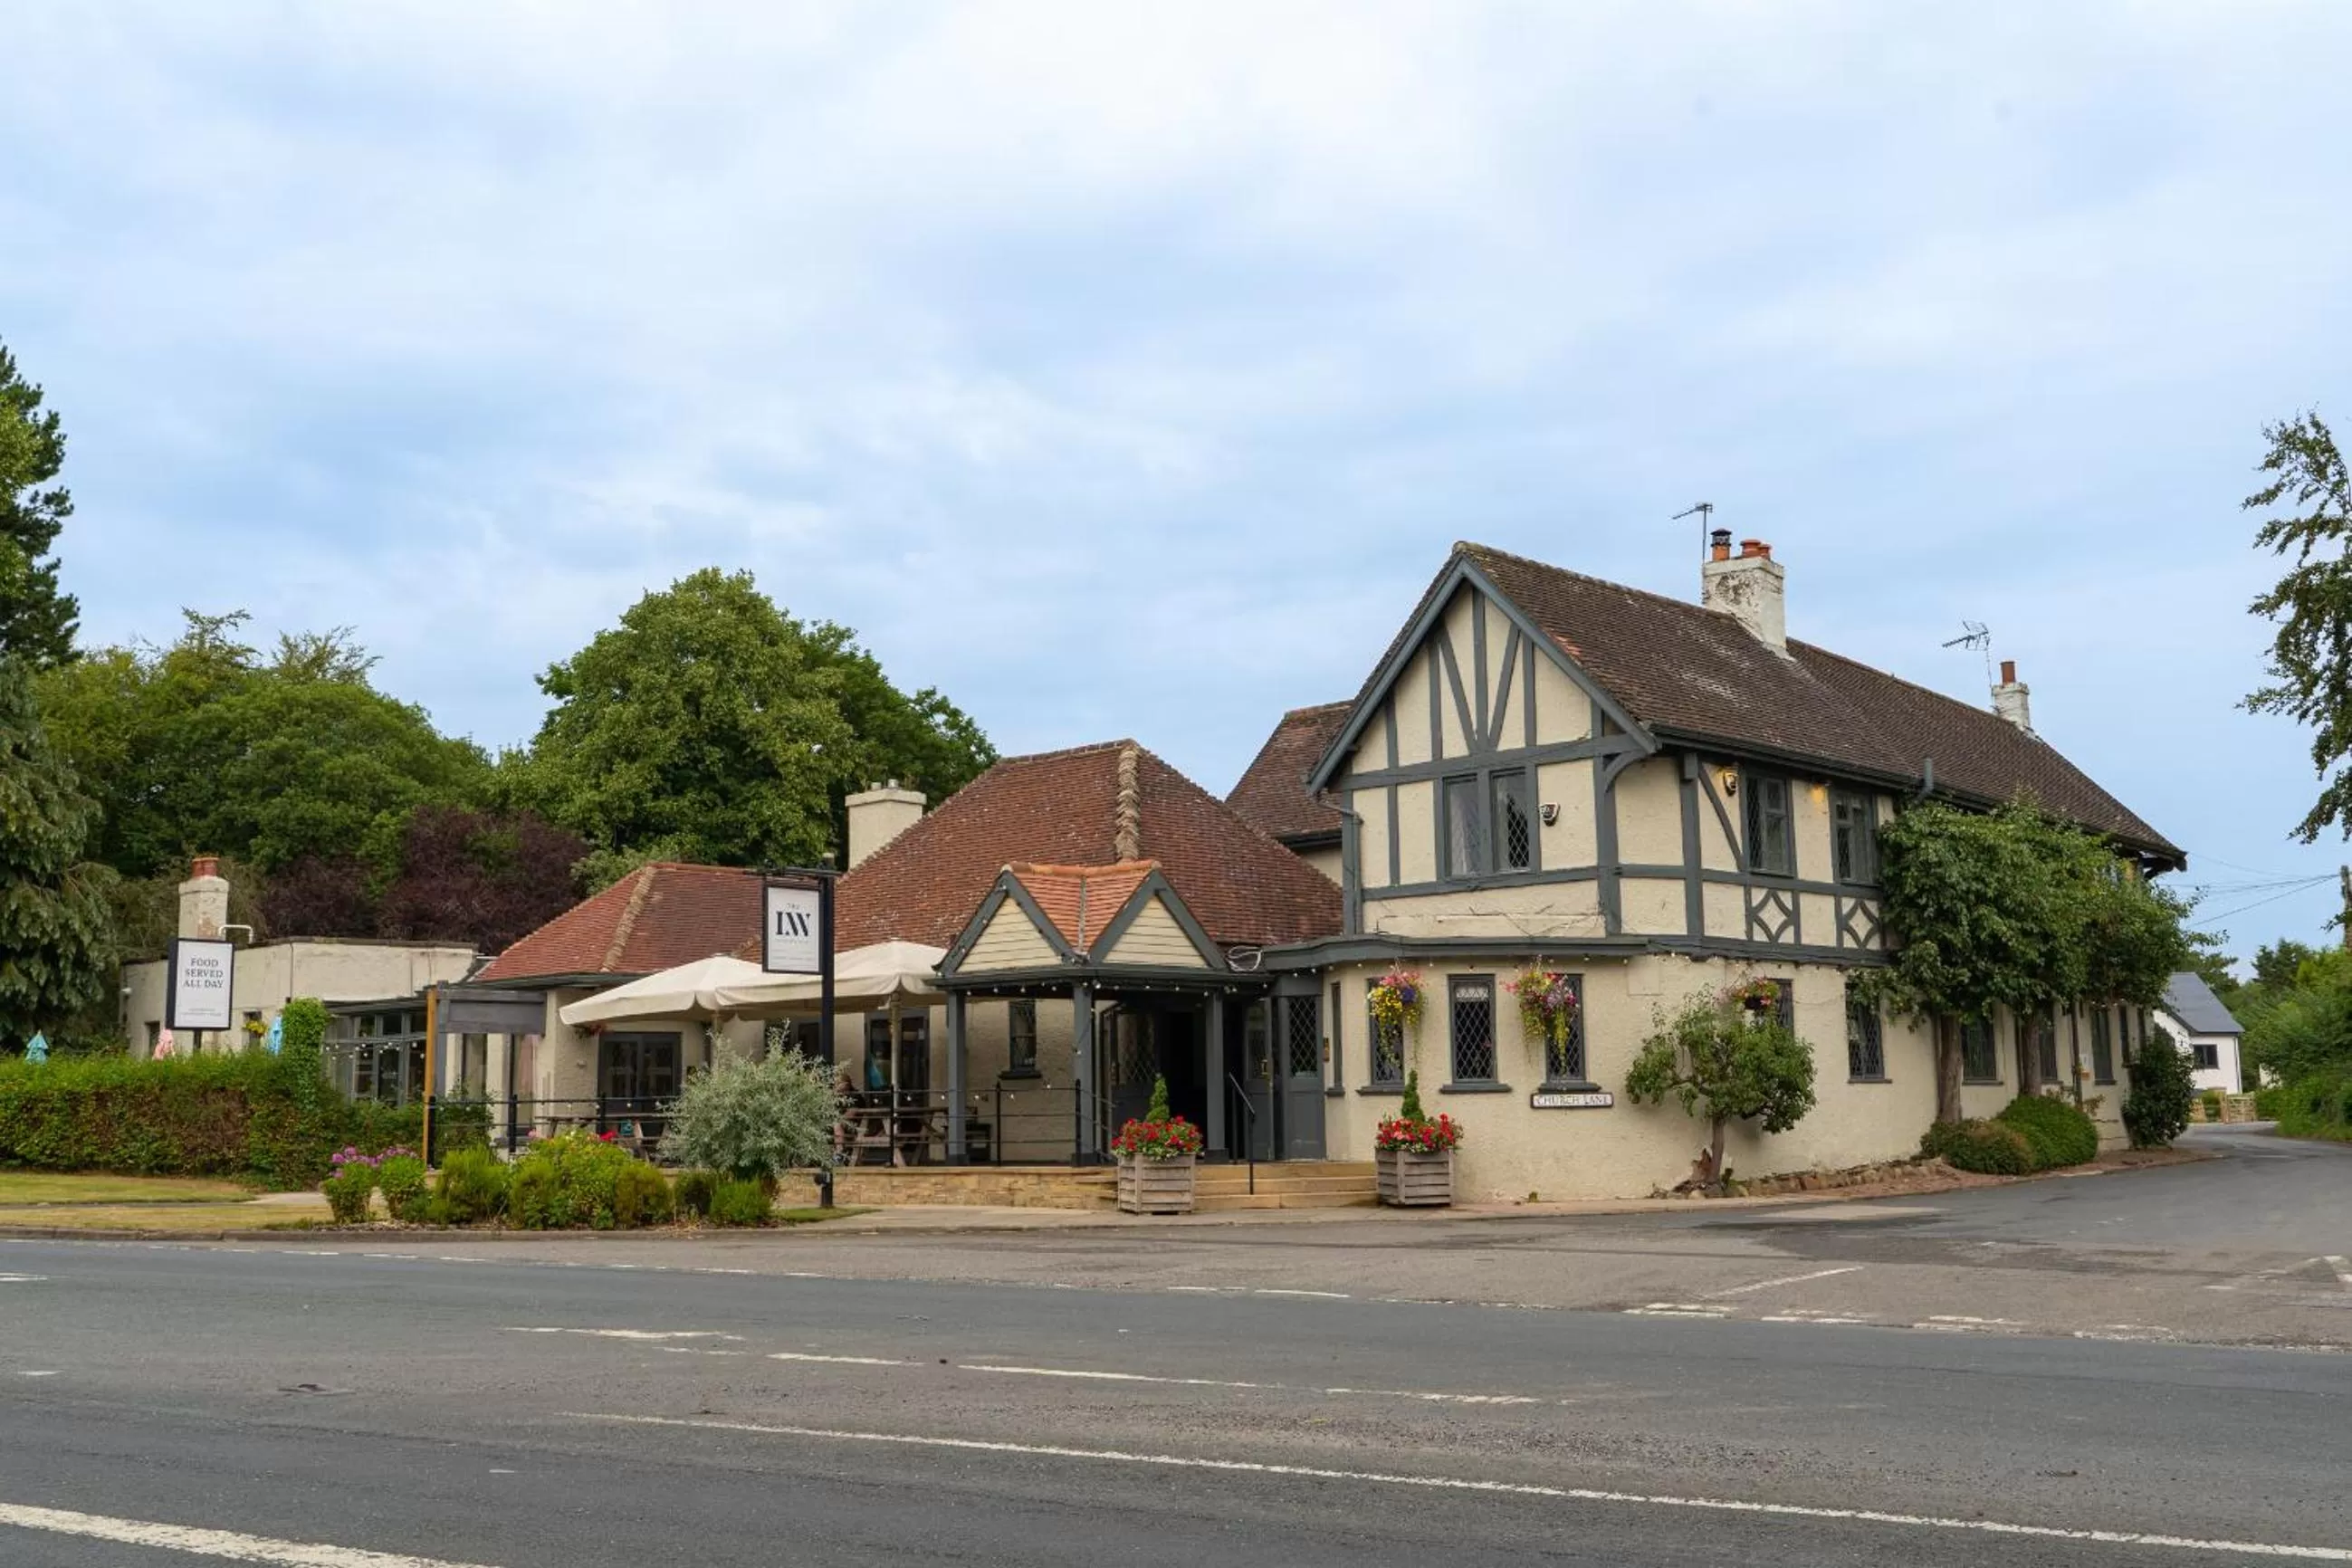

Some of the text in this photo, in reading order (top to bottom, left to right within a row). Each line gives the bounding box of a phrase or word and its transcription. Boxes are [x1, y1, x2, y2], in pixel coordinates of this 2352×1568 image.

[190, 958, 219, 967] FOOD
[185, 969, 224, 979] SERVED
[184, 979, 224, 989] ALL DAY
[1535, 1095, 1610, 1105] CHURCH LANE
